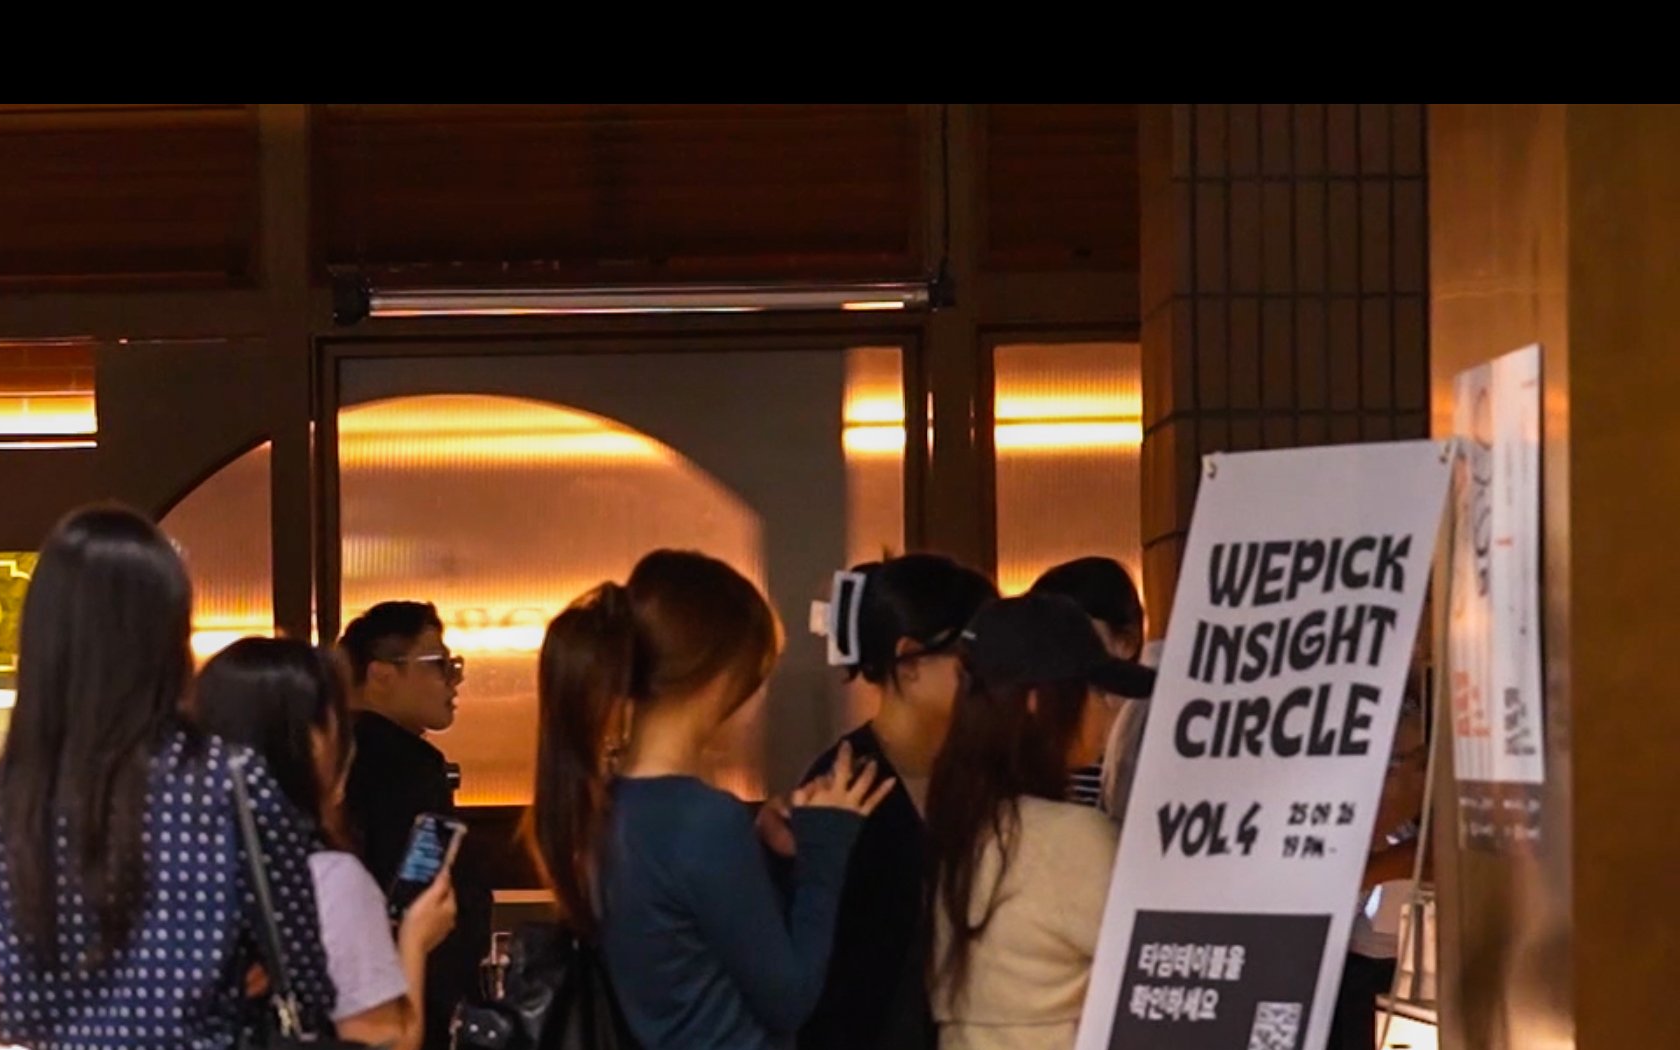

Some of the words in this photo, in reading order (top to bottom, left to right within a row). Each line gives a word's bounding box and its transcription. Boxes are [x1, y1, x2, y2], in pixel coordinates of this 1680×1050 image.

[1209, 533, 1413, 607] WEPICK
[1187, 603, 1397, 685] INSIGHT
[1174, 683, 1381, 758] CIRCLE
[1138, 943, 1246, 980] 타임테이블을
[1130, 985, 1218, 1020] 확인하세요
